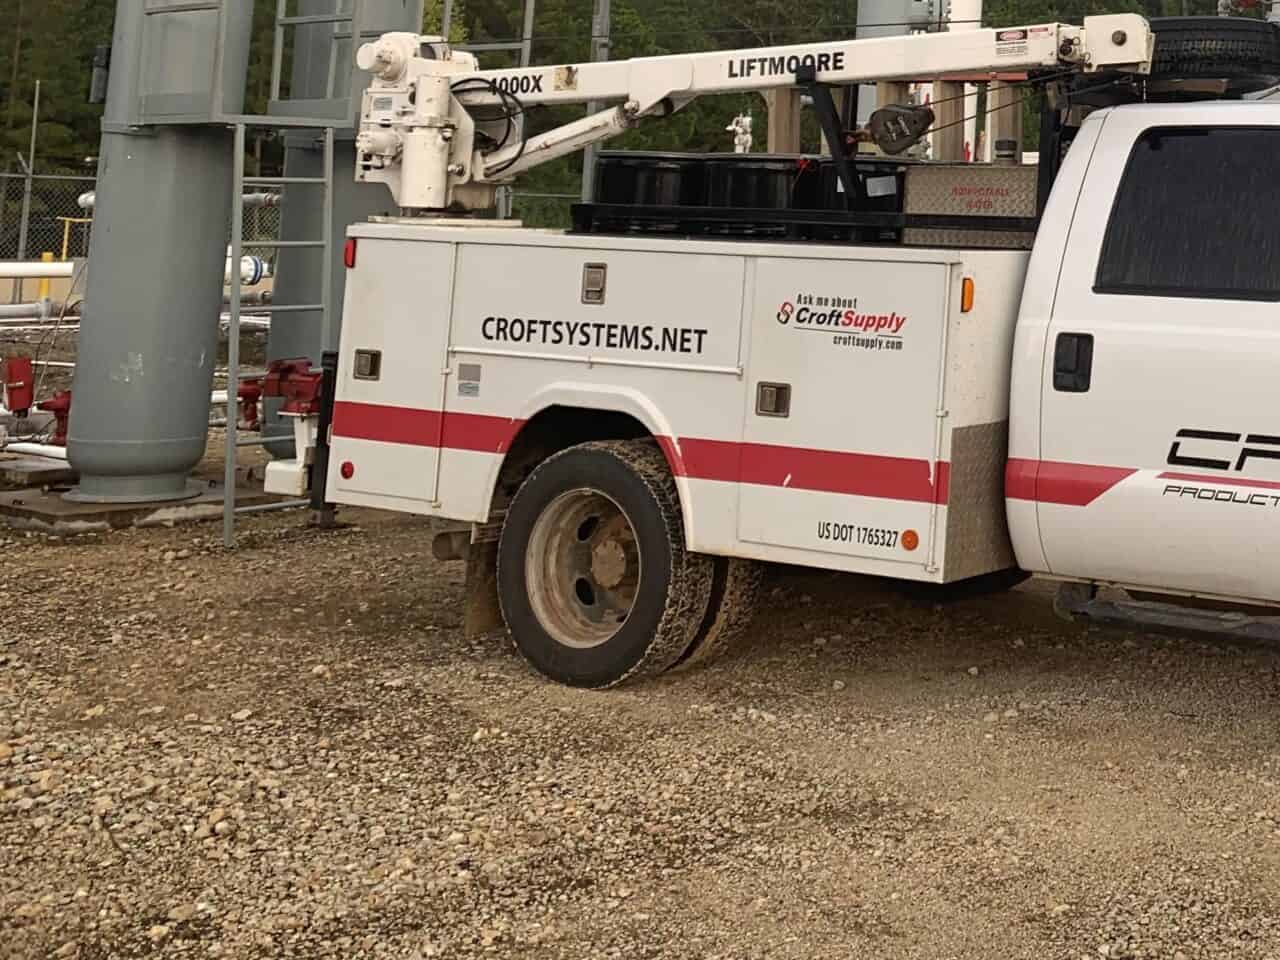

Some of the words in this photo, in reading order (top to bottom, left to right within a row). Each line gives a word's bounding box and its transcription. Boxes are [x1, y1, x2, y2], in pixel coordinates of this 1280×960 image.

[727, 51, 845, 79] LIFTMOORE
[797, 293, 813, 305] Ask
[816, 296, 829, 307] me
[832, 297, 857, 309] about
[796, 307, 907, 333] CroftSupply
[481, 316, 708, 354] CROFTSYSTEMS.NET
[833, 335, 903, 351] croftsupply.com
[817, 521, 831, 540] US
[833, 522, 855, 542] DOT
[856, 526, 899, 548] 1765327
